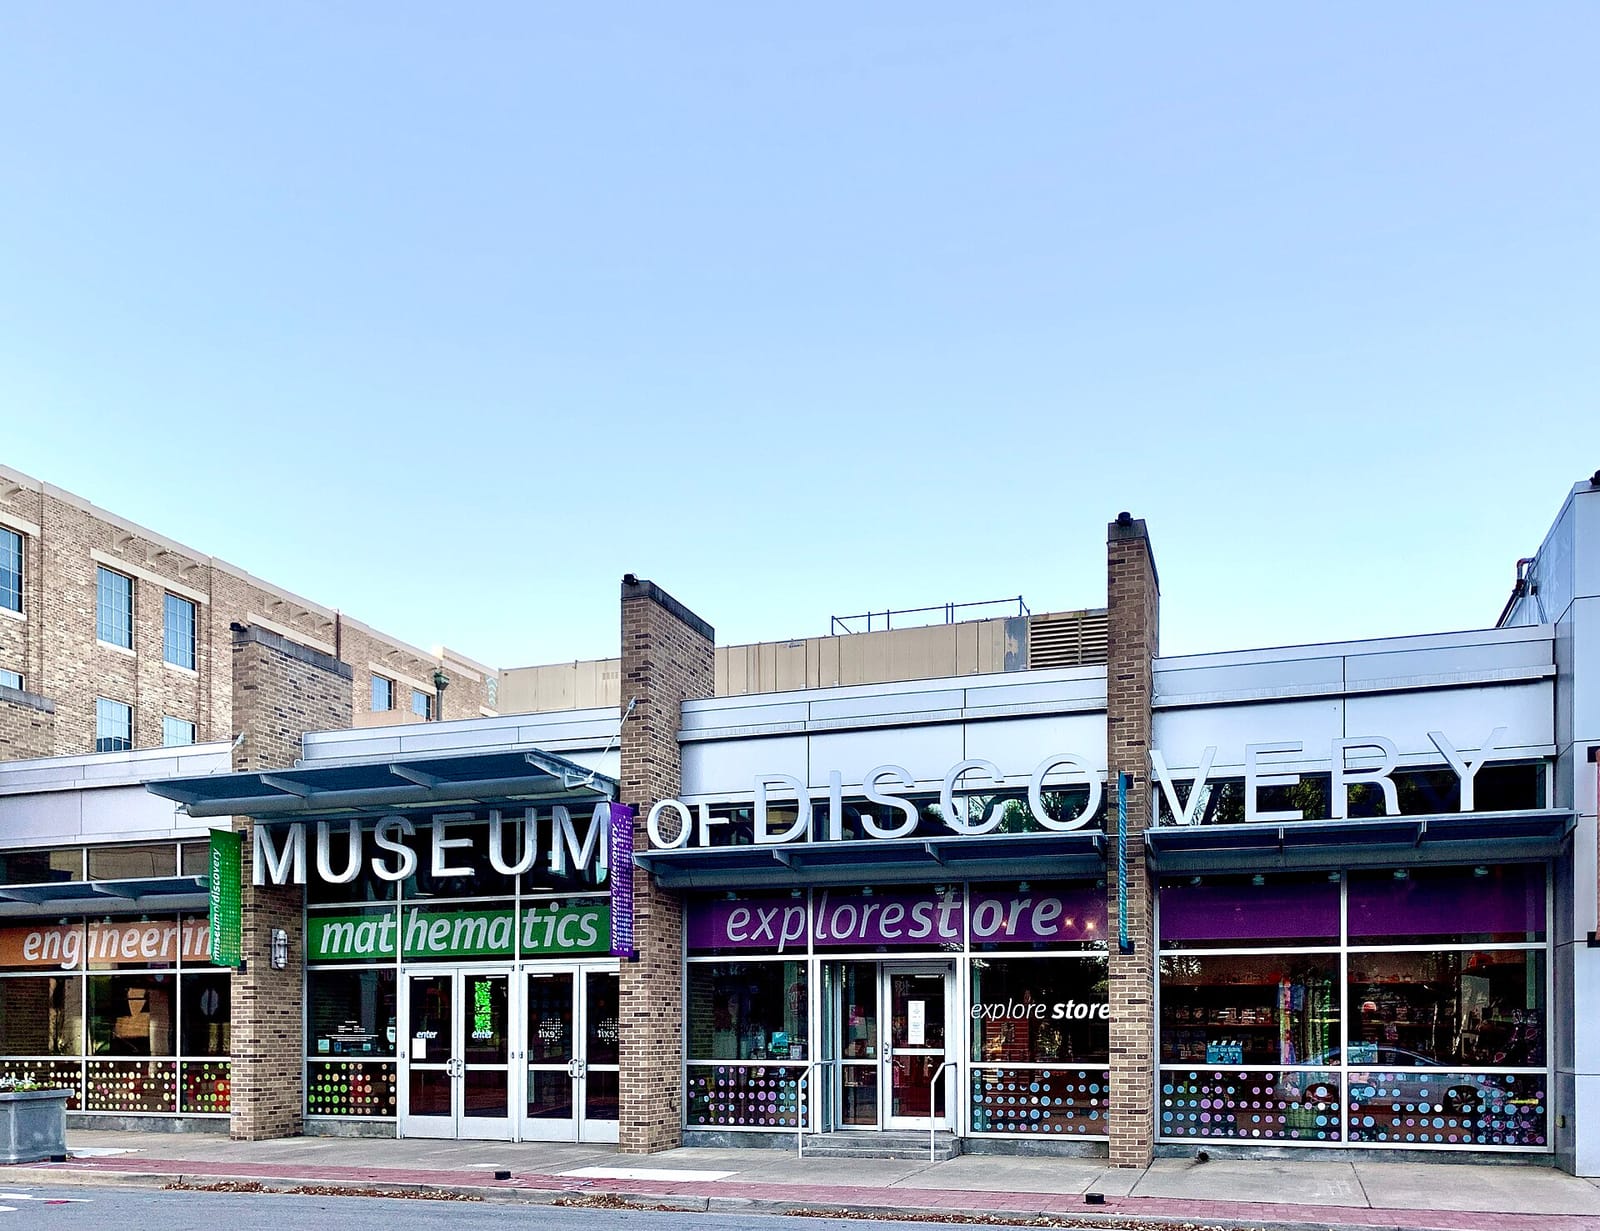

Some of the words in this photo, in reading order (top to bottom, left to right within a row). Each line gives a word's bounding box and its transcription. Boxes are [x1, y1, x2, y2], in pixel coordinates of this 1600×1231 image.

[251, 804, 609, 886] MUSEUM
[646, 799, 730, 848] OF
[23, 924, 211, 969] engineerin
[320, 903, 599, 953] mathematics
[971, 998, 1047, 1022] explore
[1051, 999, 1109, 1020] store
[416, 1030, 438, 1039] enter
